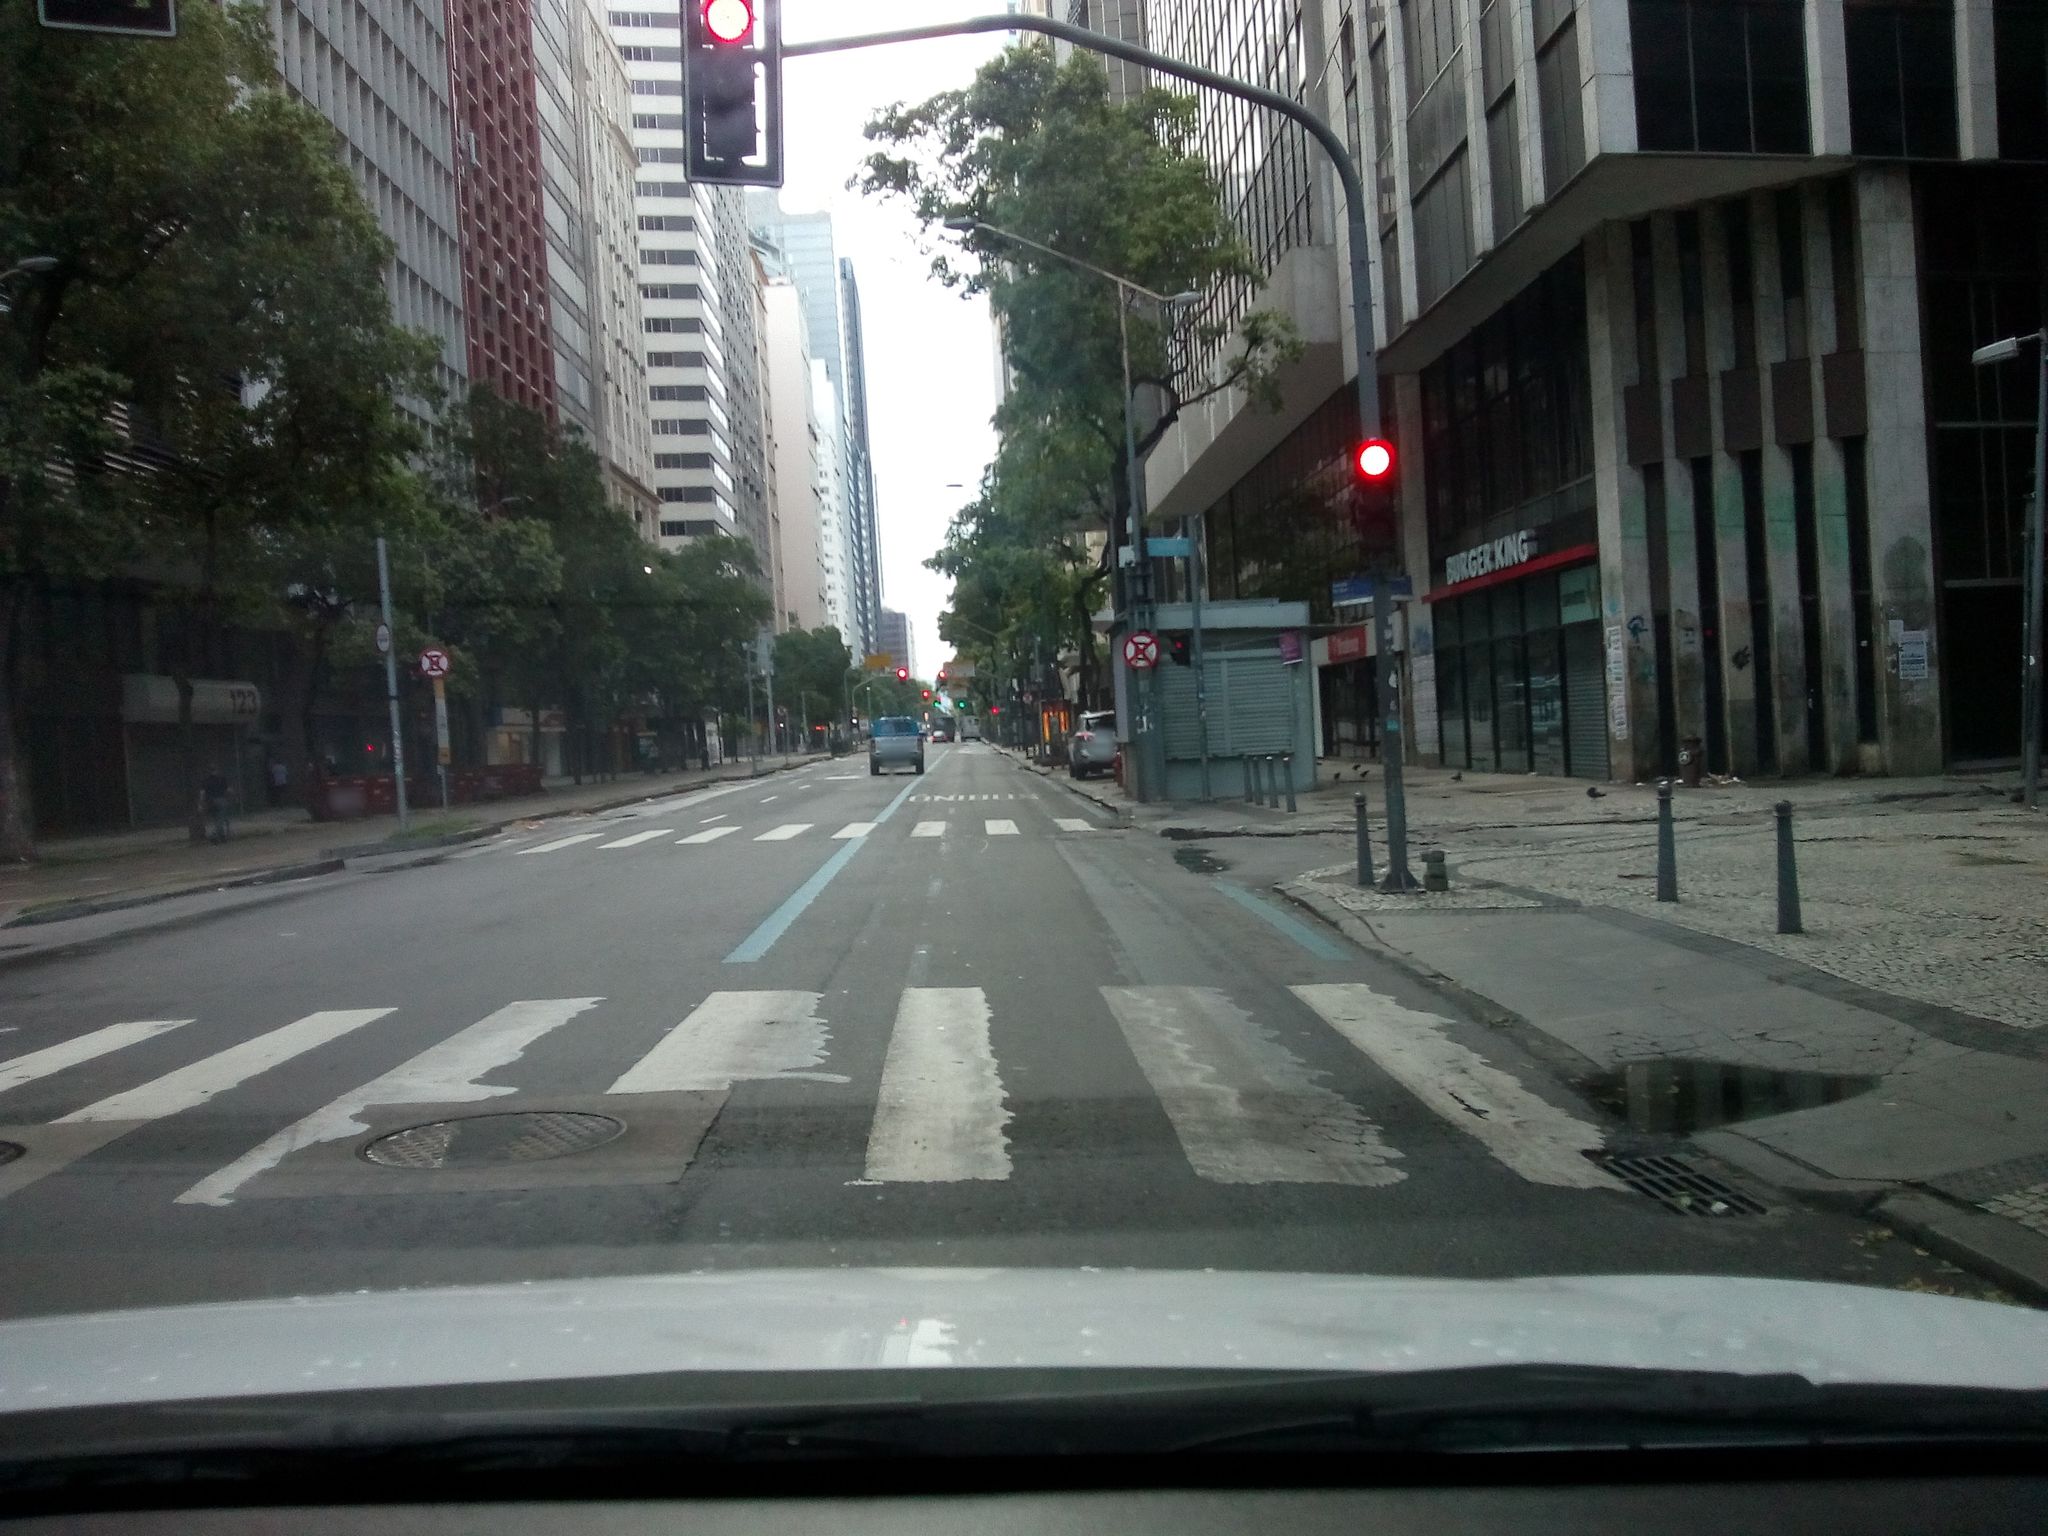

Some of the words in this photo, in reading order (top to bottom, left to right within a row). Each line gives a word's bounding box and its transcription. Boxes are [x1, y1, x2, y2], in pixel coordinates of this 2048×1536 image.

[1446, 542, 1494, 585] BURGER
[1494, 529, 1529, 570] KING
[229, 688, 258, 715] 123
